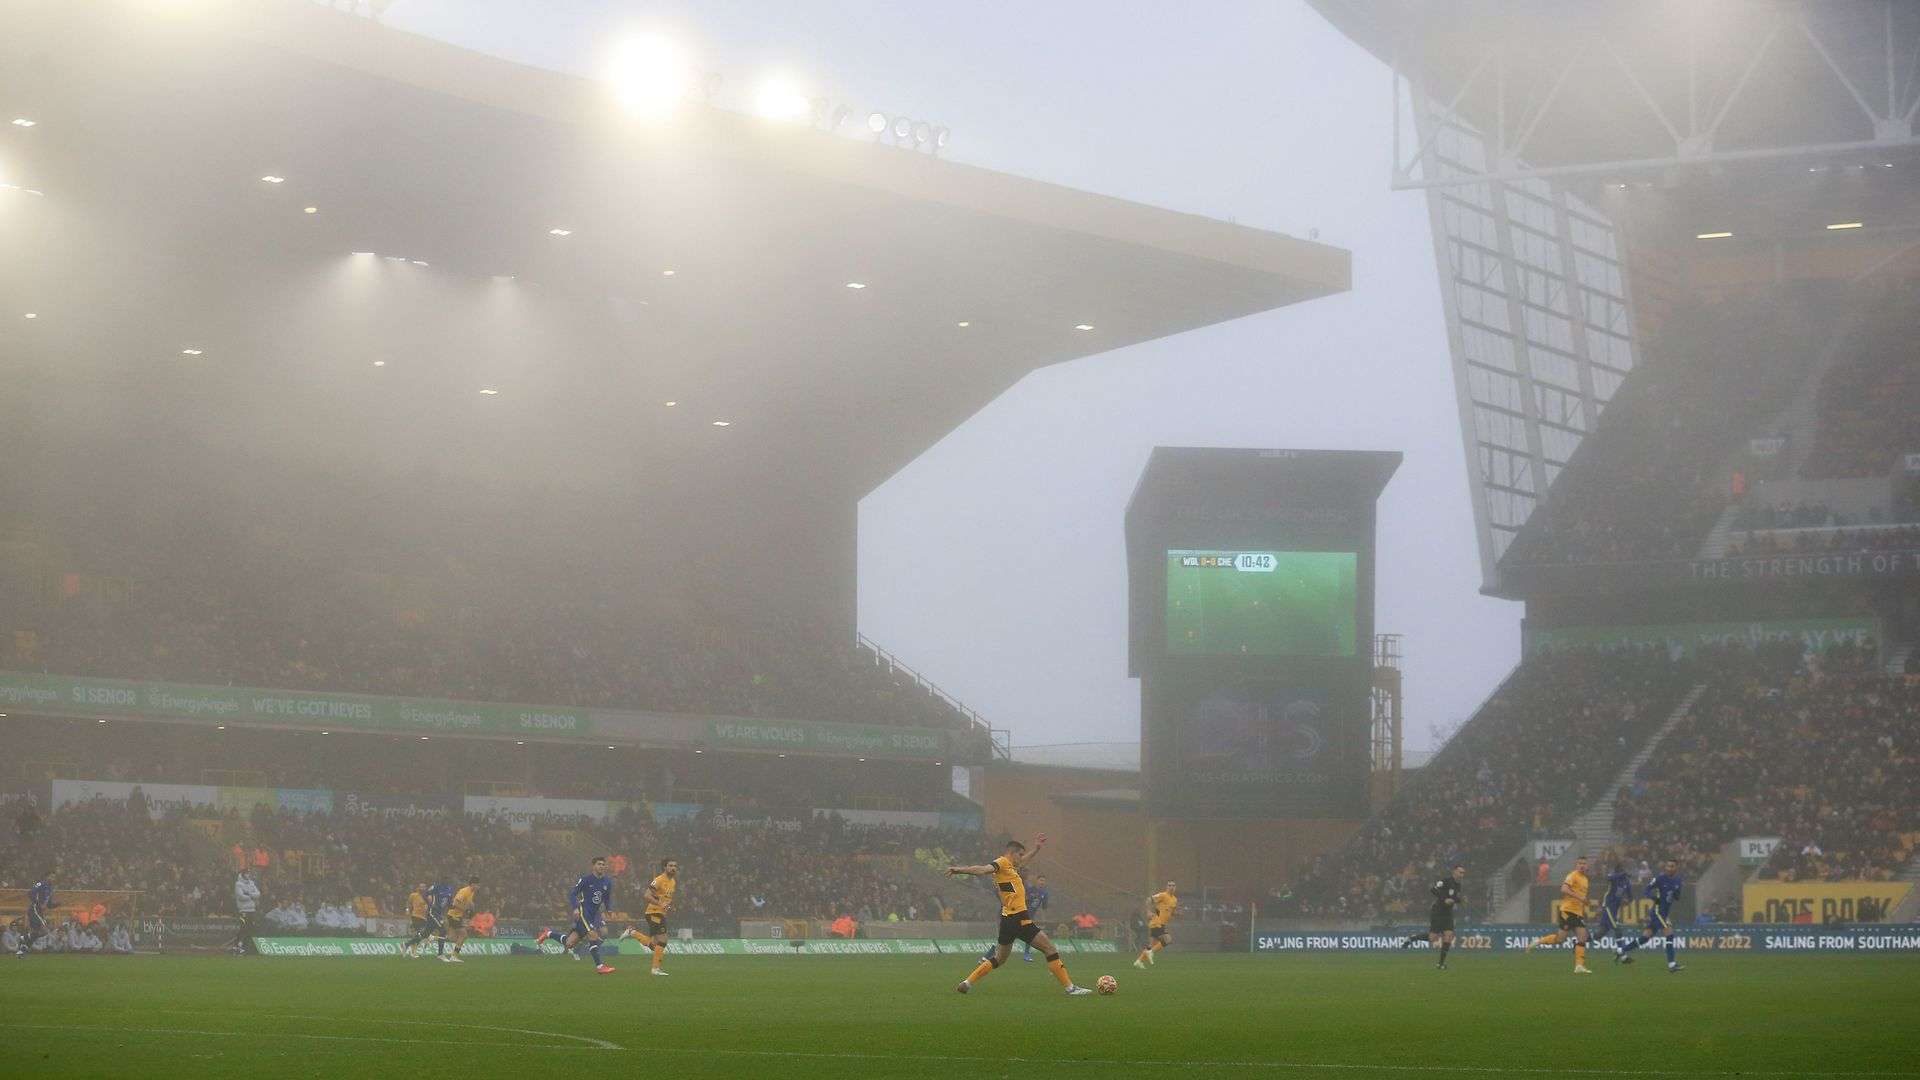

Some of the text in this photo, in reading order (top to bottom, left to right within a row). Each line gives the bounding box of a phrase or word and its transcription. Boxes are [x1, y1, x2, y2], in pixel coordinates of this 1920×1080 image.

[1183, 556, 1199, 566] WOL
[1217, 556, 1232, 566] CHE
[1690, 562, 1729, 577] THE
[1741, 557, 1862, 575] STRENGTH
[1873, 555, 1902, 572] OF
[72, 687, 136, 705] SI SENOR
[160, 695, 241, 714] EnergyAngels
[294, 700, 326, 716] GOT
[327, 702, 372, 719] NEVES
[715, 723, 806, 743] WE ARE WOLVES
[1542, 846, 1565, 857] NL1
[1749, 844, 1771, 855] PL1
[351, 943, 395, 954] BRUNO
[1306, 937, 1339, 949] FROM
[1461, 936, 1492, 949] 2022
[1689, 937, 1715, 948] MAY
[1719, 936, 1752, 948] 2022
[1766, 936, 1920, 949] SAILING FROM SOUTHAM
